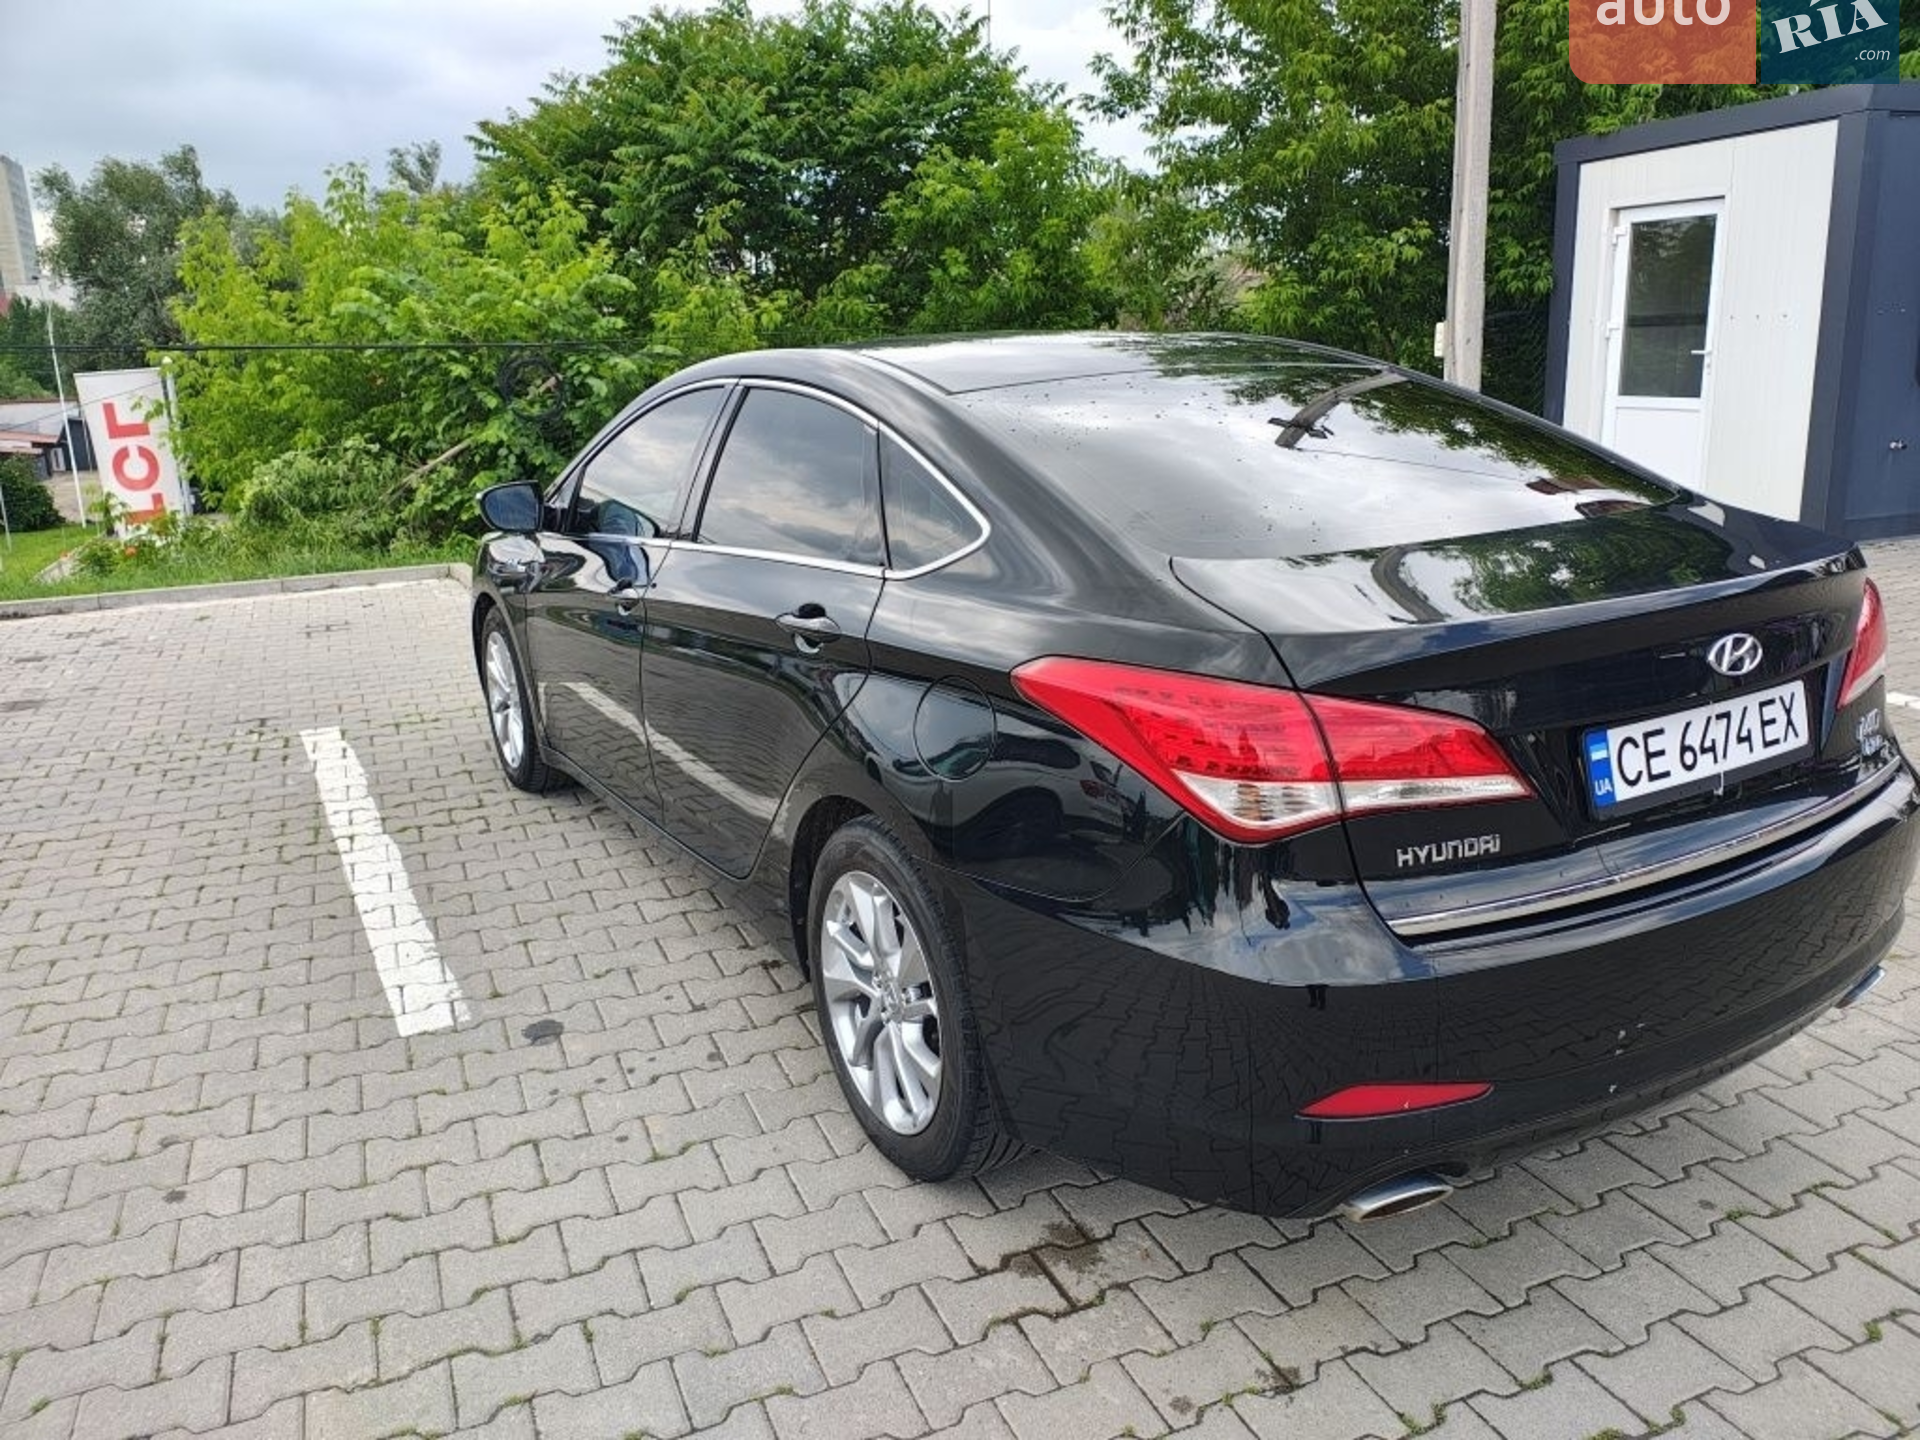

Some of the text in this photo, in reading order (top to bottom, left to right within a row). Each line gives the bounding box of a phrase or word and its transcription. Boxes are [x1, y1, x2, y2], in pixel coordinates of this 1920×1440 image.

[1616, 728, 1671, 787] CE
[1679, 705, 1754, 772] 6474
[1758, 692, 1800, 749] EX
[1594, 776, 1613, 796] UA
[1396, 833, 1500, 868] HYUNDAI
